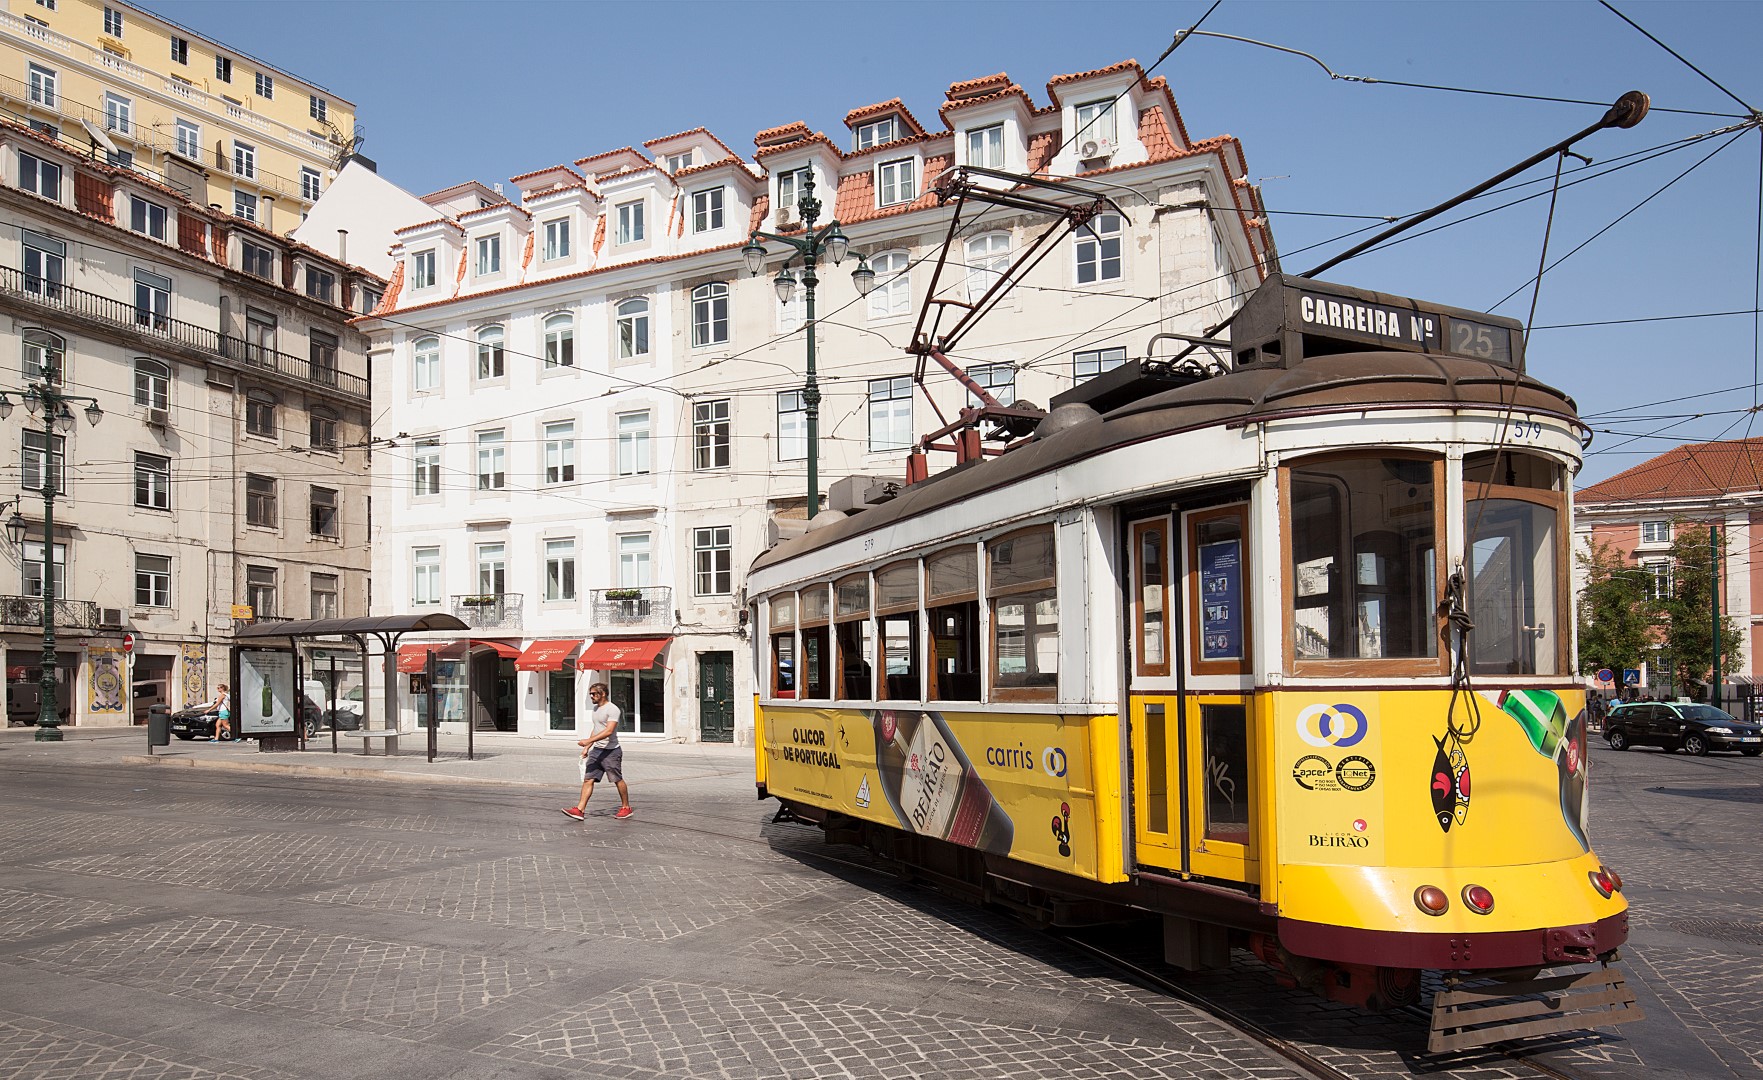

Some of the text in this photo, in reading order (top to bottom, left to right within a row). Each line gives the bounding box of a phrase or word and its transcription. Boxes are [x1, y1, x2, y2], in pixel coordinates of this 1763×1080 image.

[1301, 296, 1401, 338] CARREIRA
[1457, 323, 1493, 358] 25
[1514, 420, 1542, 440] 579
[864, 538, 875, 552] 579
[793, 728, 825, 746] O LICOR
[783, 746, 841, 769] DE PORTUGAL
[986, 741, 1034, 770] carris
[1300, 769, 1326, 778] apcer
[1343, 770, 1368, 778] IQNet
[913, 741, 945, 830] BEIRÃO
[1309, 835, 1369, 848] BEIRÃO
